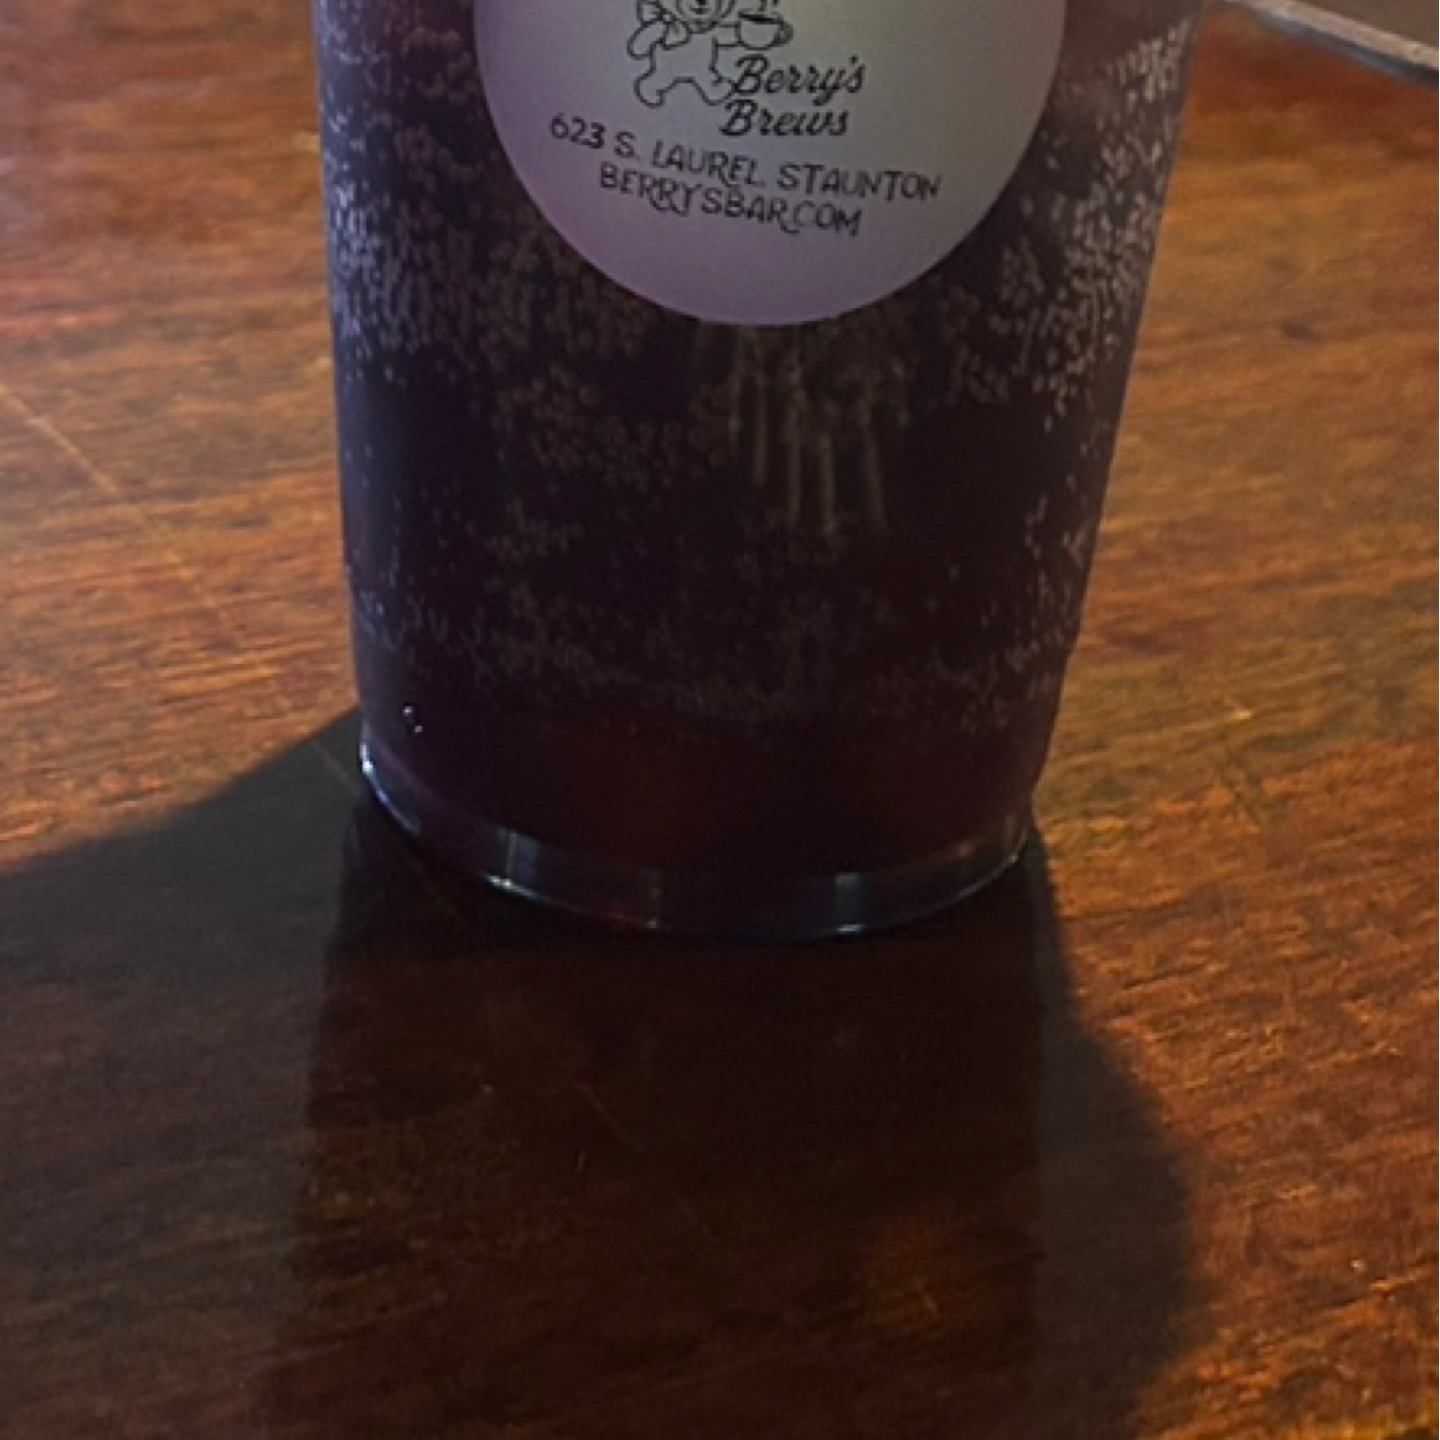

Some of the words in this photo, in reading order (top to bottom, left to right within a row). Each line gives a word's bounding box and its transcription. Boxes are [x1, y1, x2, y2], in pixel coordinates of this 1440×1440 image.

[731, 55, 867, 108] Berry's
[719, 99, 850, 138] Brews
[550, 114, 606, 150] 623
[776, 163, 943, 201] STAUNTON
